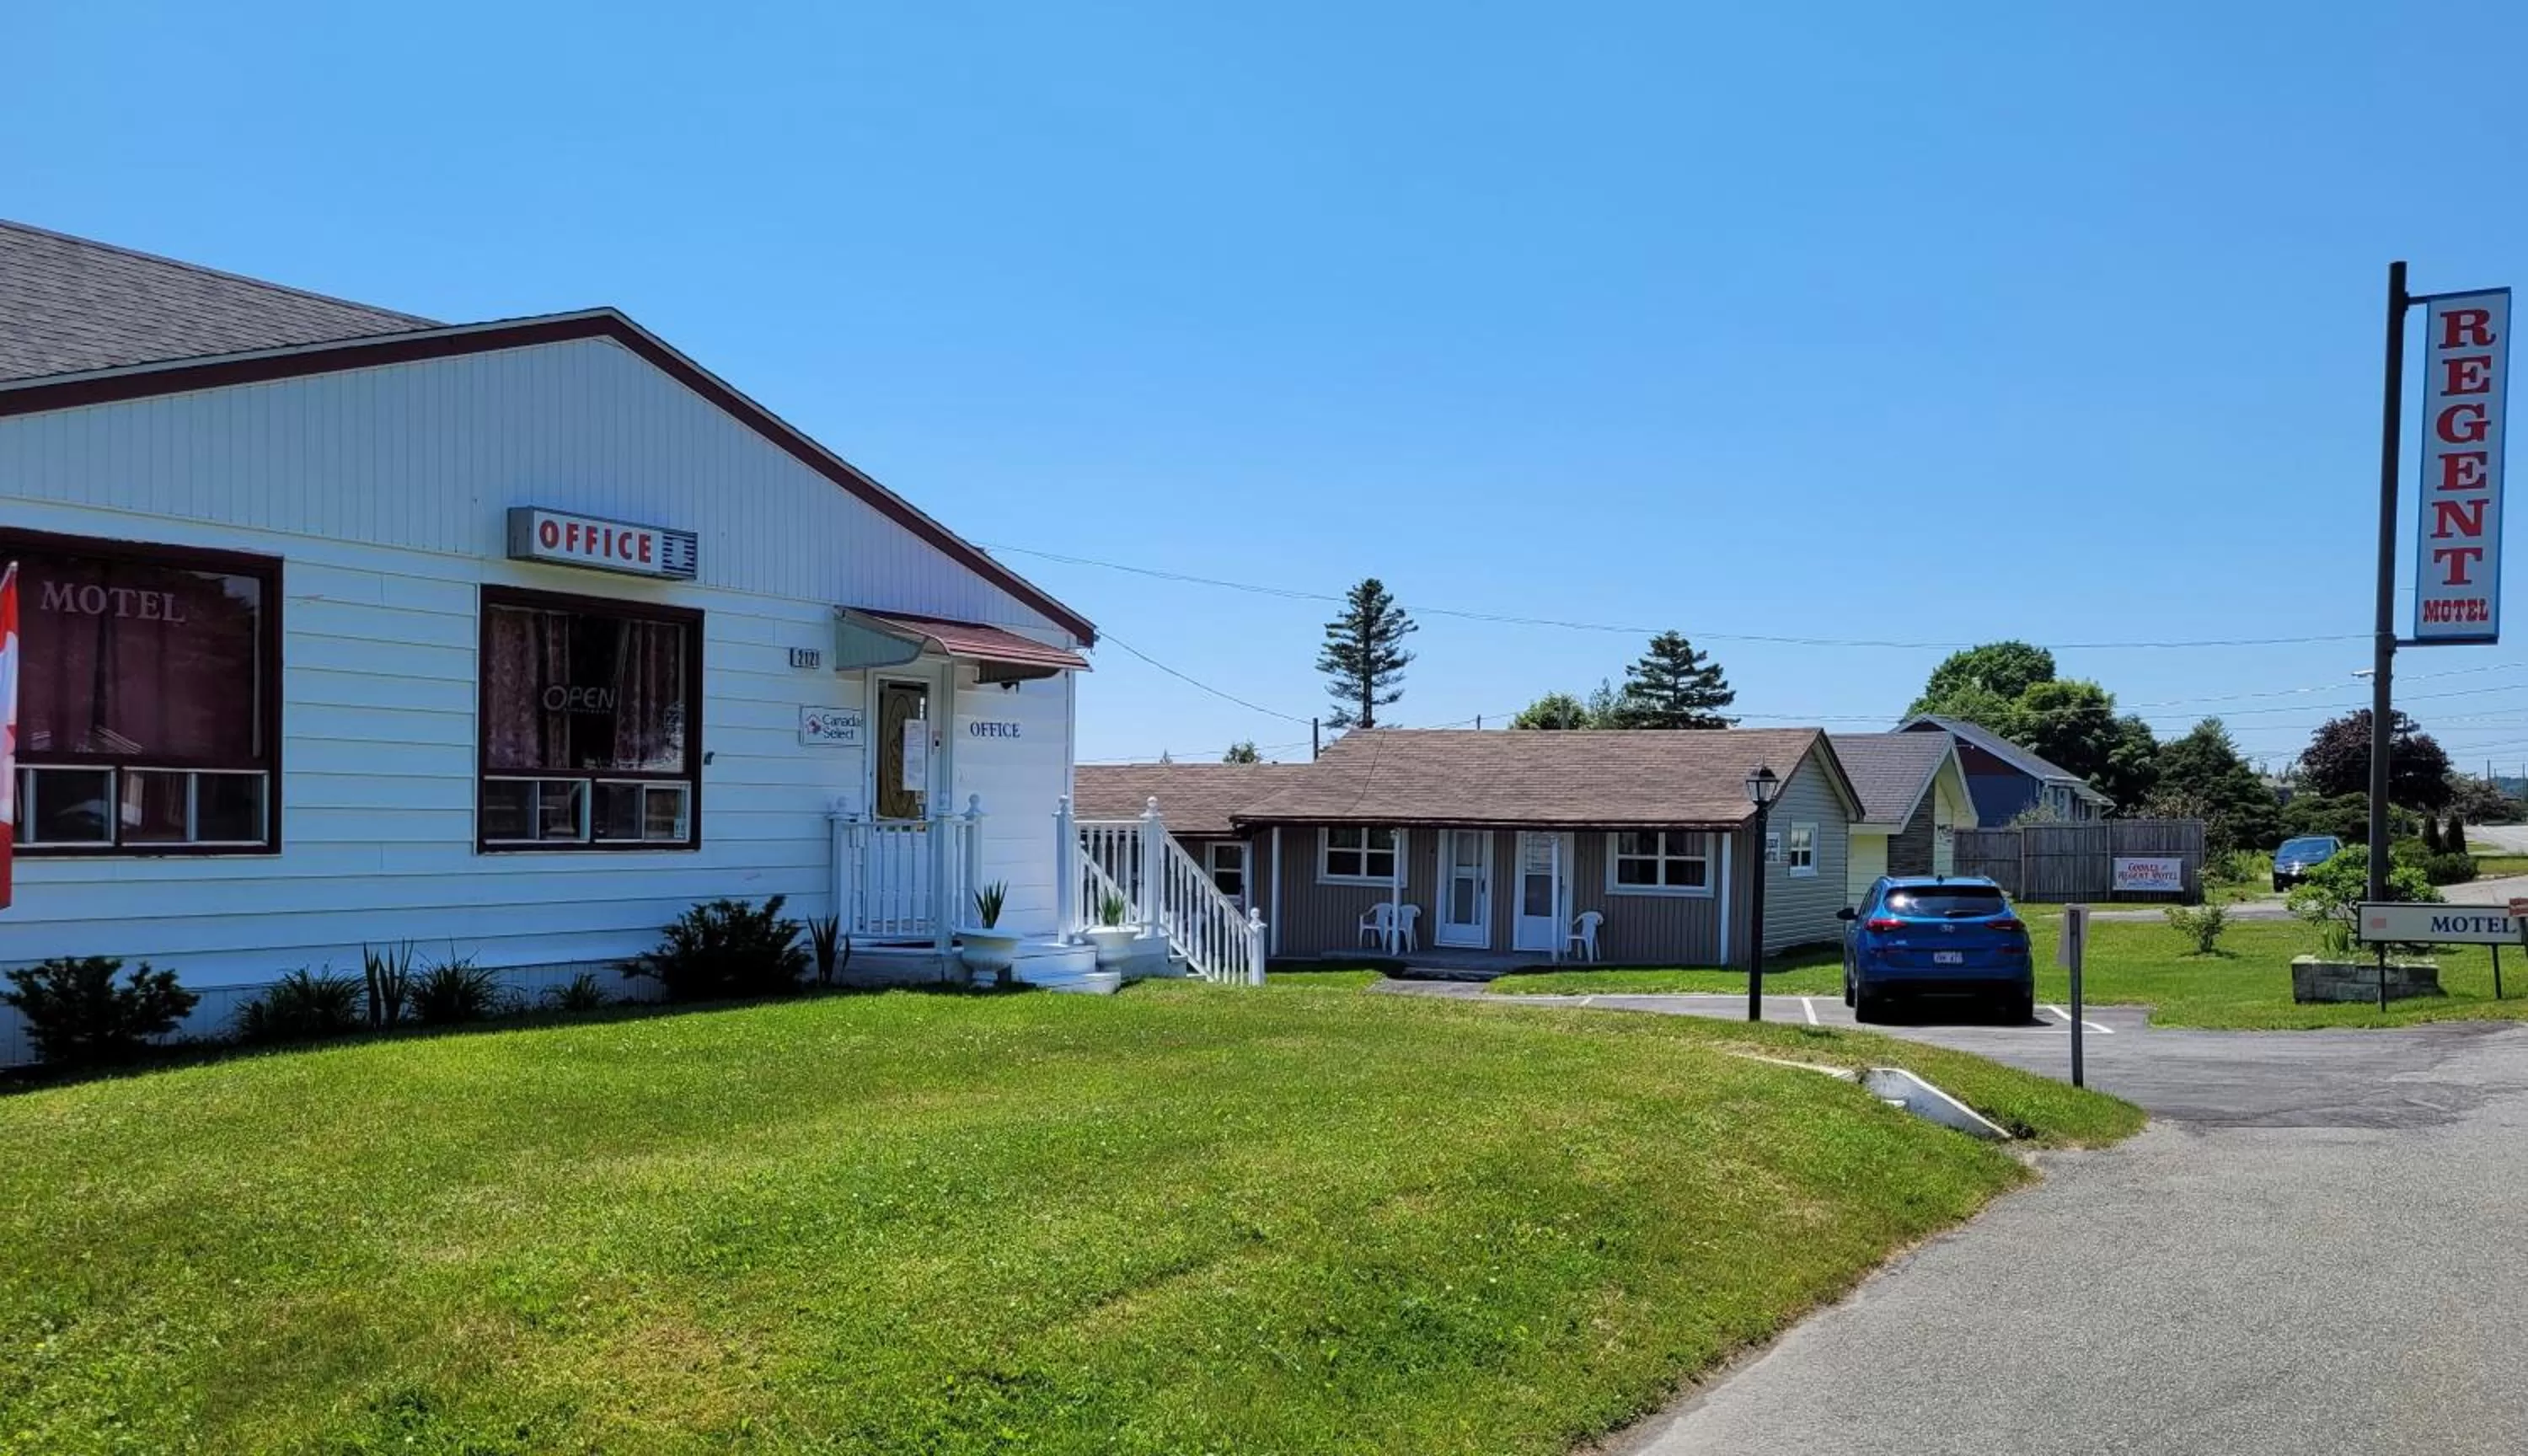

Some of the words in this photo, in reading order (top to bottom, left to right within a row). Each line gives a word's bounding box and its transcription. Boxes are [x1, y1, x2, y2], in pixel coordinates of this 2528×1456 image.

[2430, 308, 2496, 586] REGENT
[539, 519, 651, 564] OFFICE
[40, 579, 185, 623] MOTEL
[2424, 598, 2488, 622] MOTEL
[543, 685, 616, 710] OPEN
[823, 729, 854, 740] Select
[970, 722, 1020, 738] OFFICE
[2430, 916, 2517, 933] MOTEL
